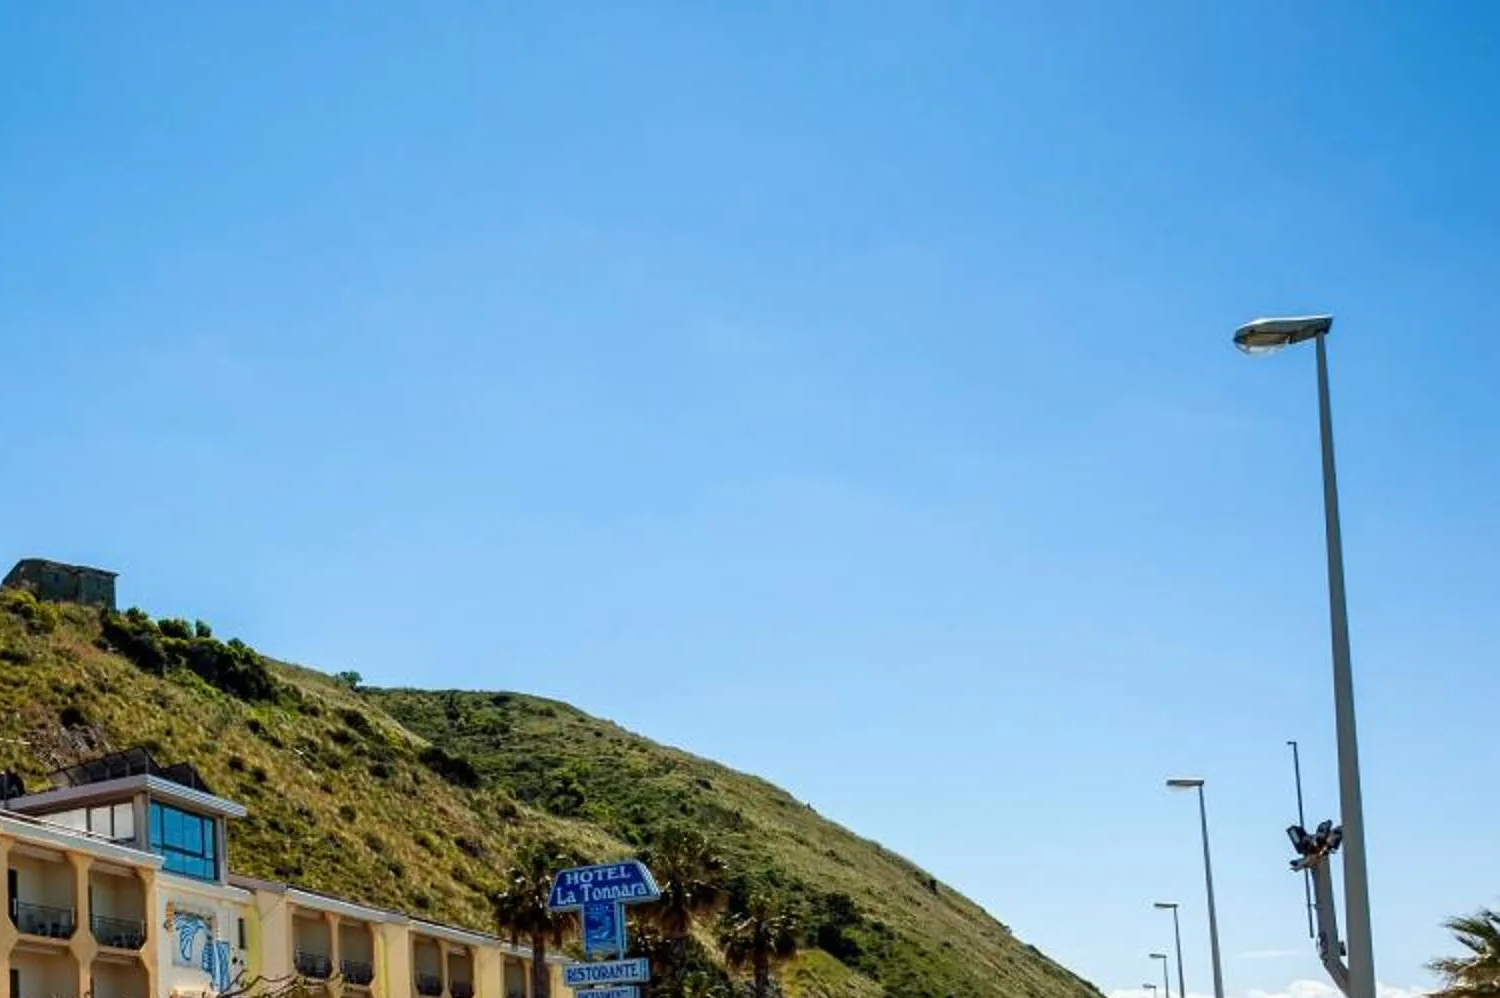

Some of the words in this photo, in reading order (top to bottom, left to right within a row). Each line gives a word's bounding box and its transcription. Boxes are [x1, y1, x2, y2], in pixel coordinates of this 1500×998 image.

[565, 866, 631, 885] HOTEL
[556, 887, 576, 905] La
[580, 881, 647, 902] Tonnara
[567, 962, 638, 982] RISTORANTE
